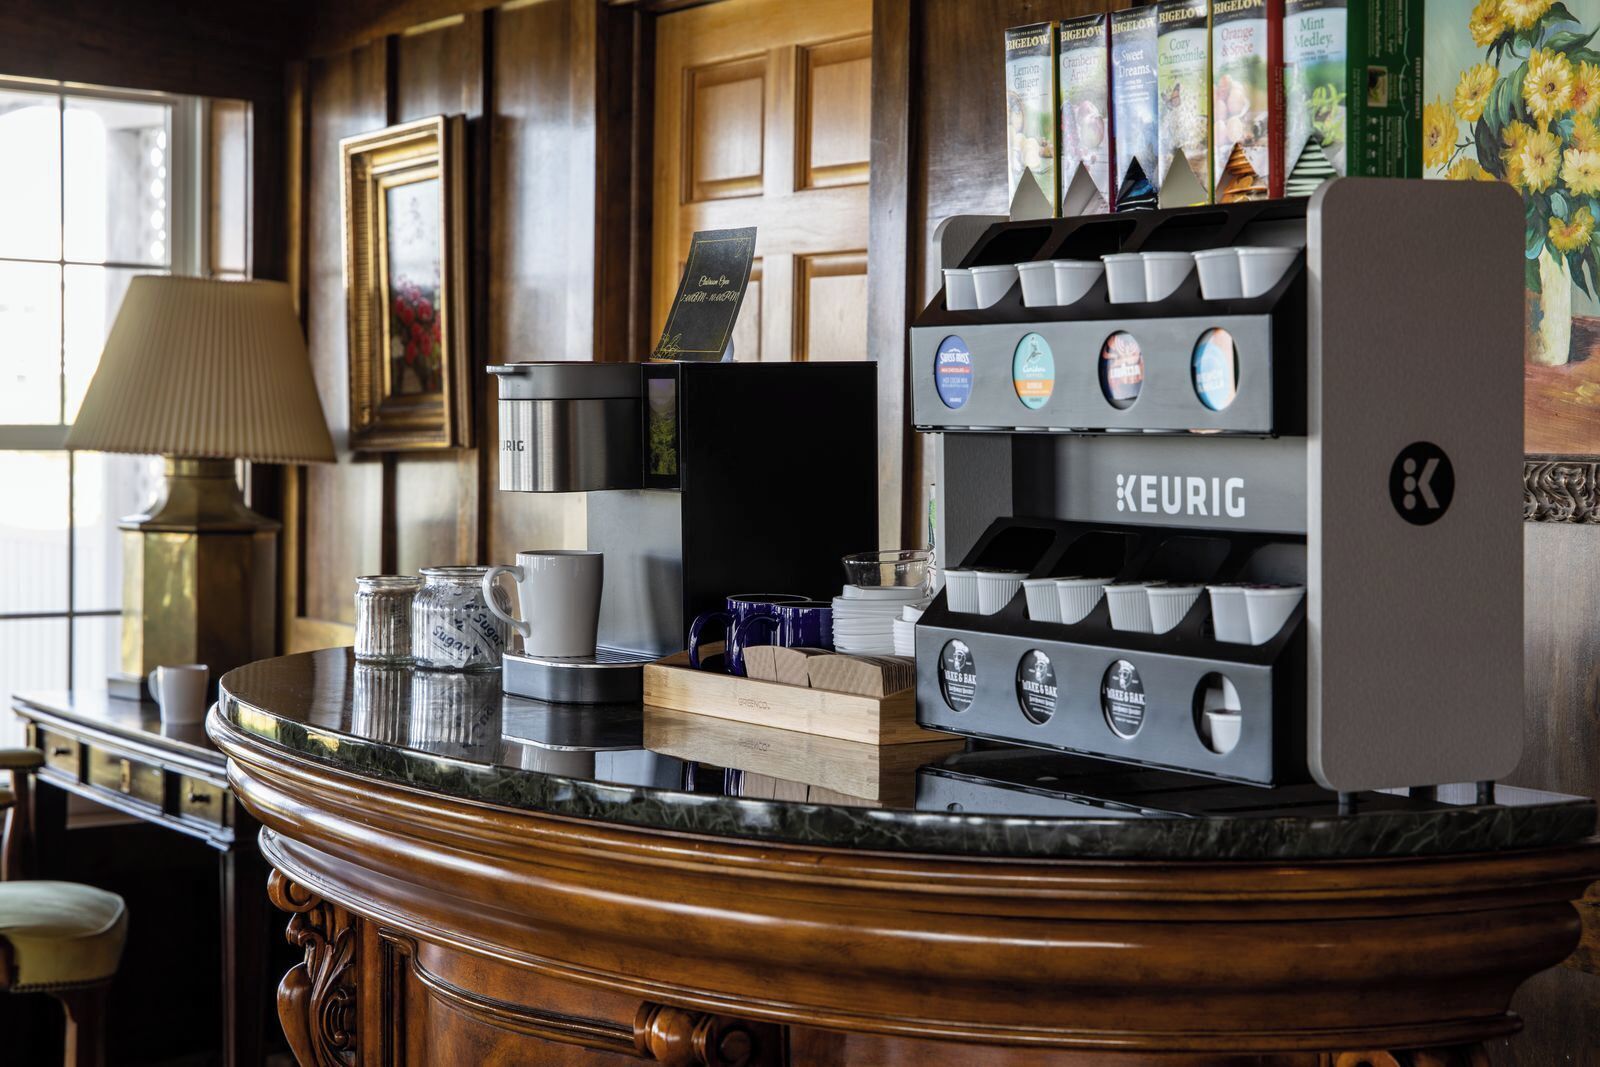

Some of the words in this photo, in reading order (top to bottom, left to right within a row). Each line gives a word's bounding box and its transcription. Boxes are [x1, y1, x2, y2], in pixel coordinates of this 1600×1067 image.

[1158, 5, 1206, 24] BIGELOW
[1213, 0, 1262, 14] BIGELOW
[1111, 17, 1154, 34] BIGELOW
[1300, 17, 1324, 32] Mint
[1060, 25, 1104, 42] BIGELOW
[1221, 26, 1254, 41] Orange
[1006, 34, 1049, 50] BIGELOW
[1169, 38, 1191, 52] Cozy
[1221, 44, 1228, 57] &
[1230, 42, 1253, 57] Spice
[1062, 53, 1101, 68] Cranberry
[1121, 49, 1144, 63] Sweet
[1013, 64, 1039, 77] Lemon
[1014, 77, 1040, 90] Ginger
[1116, 474, 1245, 518] KEURIG
[473, 613, 504, 647] Sugar
[432, 625, 471, 654] Sugar
[1022, 680, 1040, 694] WAKE
[1106, 688, 1124, 702] WAKE
